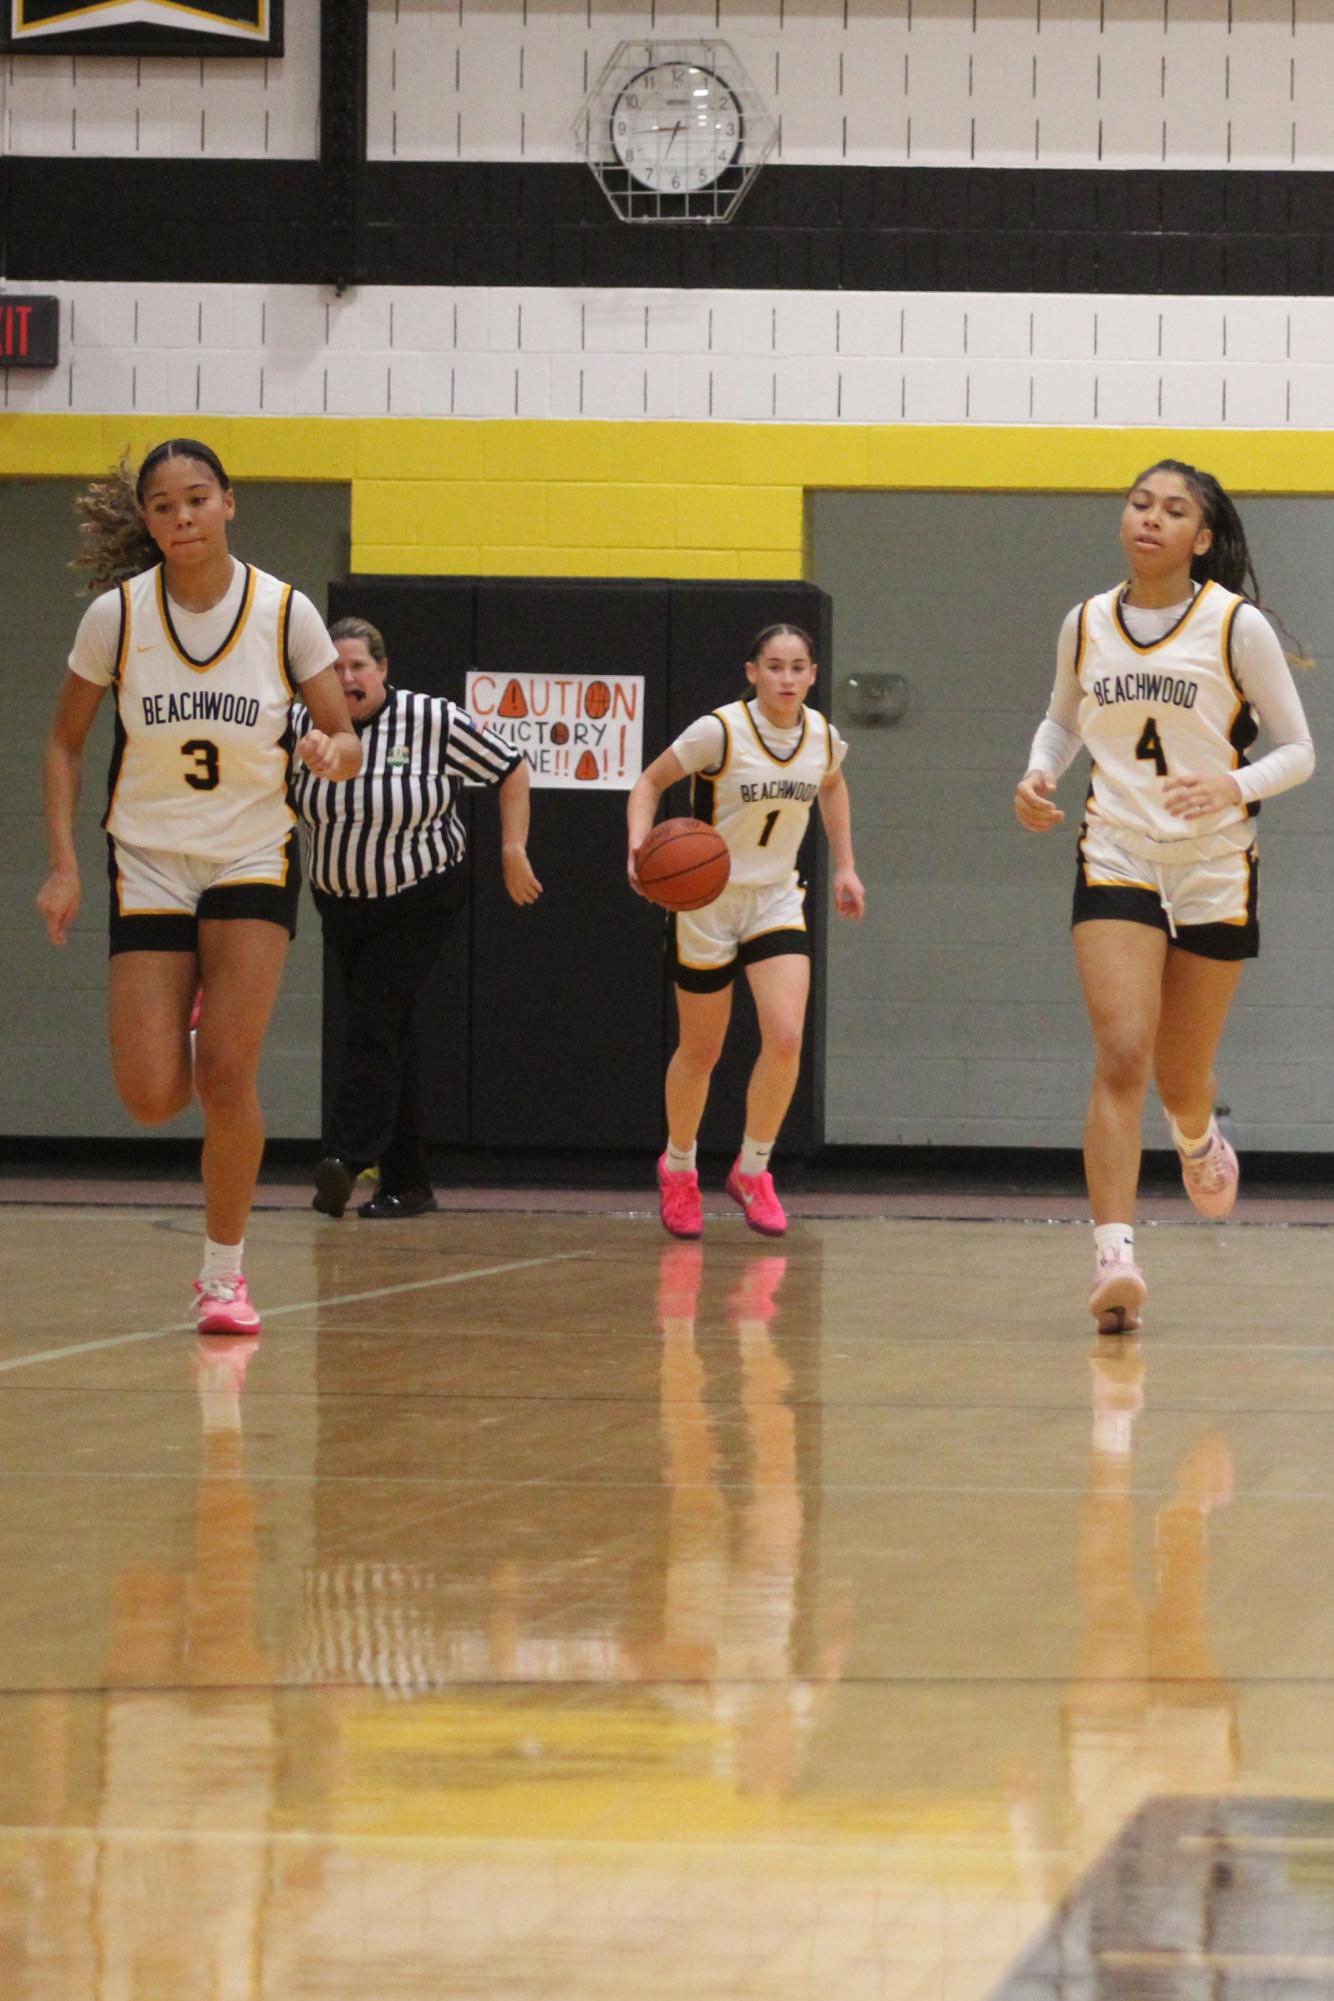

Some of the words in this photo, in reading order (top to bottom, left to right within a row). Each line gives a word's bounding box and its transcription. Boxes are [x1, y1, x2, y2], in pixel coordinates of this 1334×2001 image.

[671, 69, 685, 81] 12
[625, 95, 639, 108] 10
[719, 96, 729, 110] 2
[617, 122, 626, 135] 9
[725, 123, 735, 137] 3
[625, 149, 634, 163] 8
[717, 150, 727, 162] 4
[645, 168, 654, 181] 7
[699, 168, 708, 182] 5
[671, 175, 681, 189] 6
[0, 305, 33, 356] IT
[1093, 672, 1198, 709] BEACHWOOD
[471, 675, 637, 721] CAUTION
[142, 691, 260, 727] BEACHWOOD
[1135, 716, 1168, 776] 4
[180, 739, 220, 791] 3
[757, 809, 781, 847] 1
